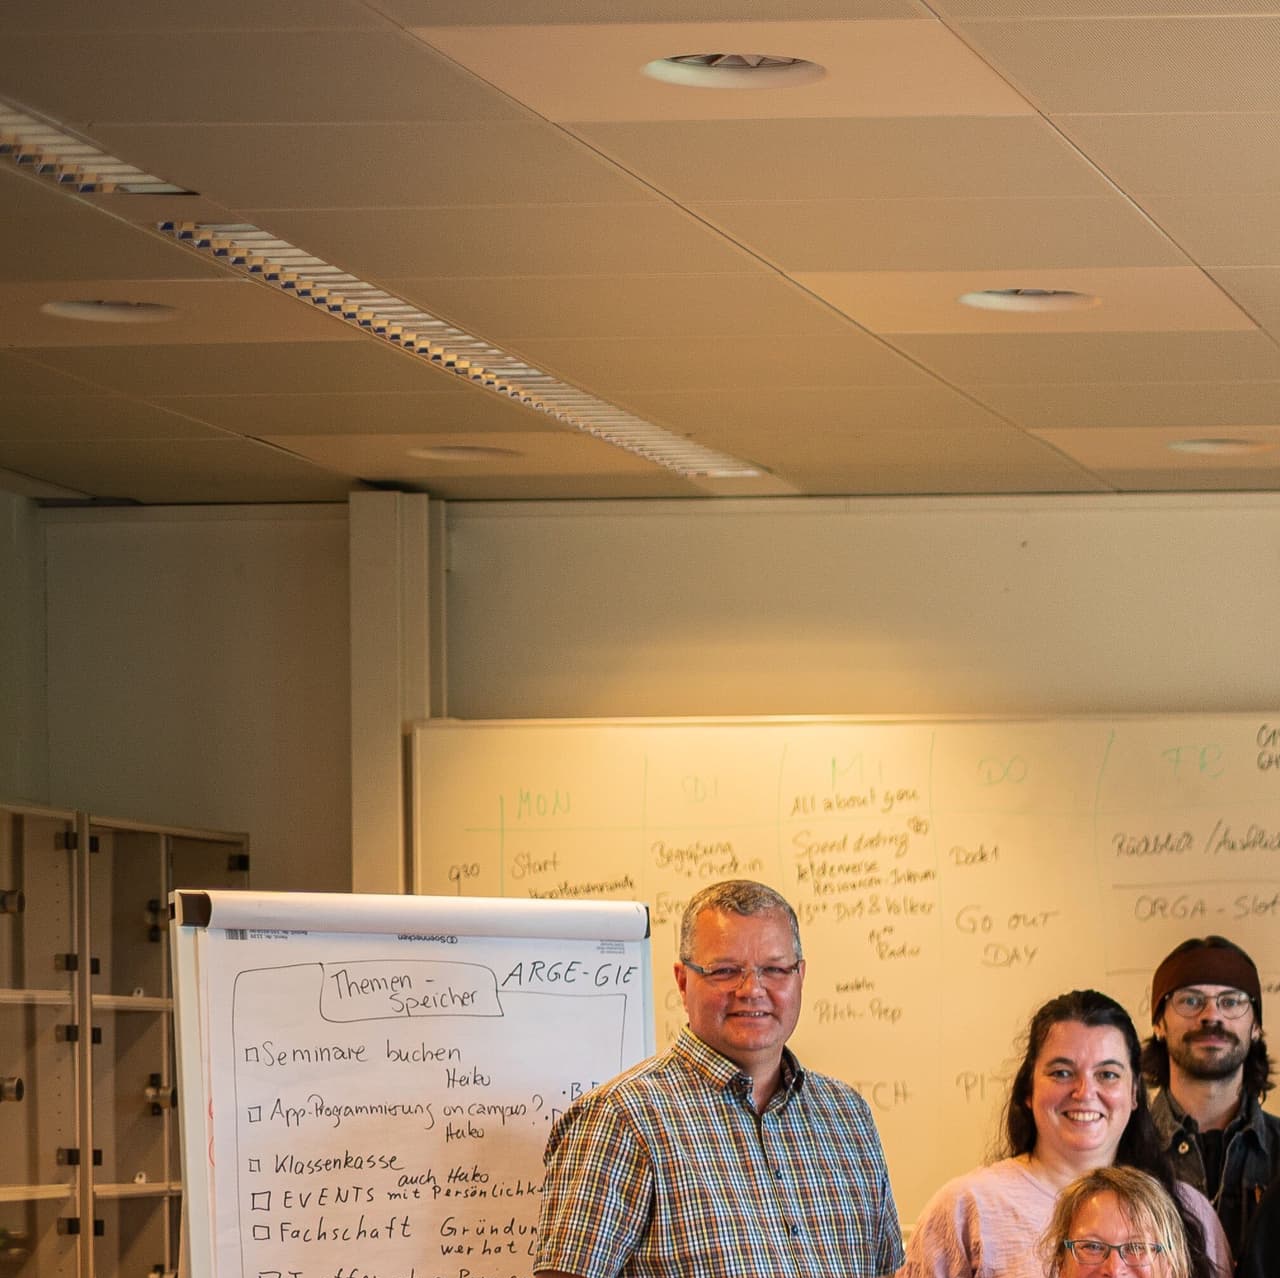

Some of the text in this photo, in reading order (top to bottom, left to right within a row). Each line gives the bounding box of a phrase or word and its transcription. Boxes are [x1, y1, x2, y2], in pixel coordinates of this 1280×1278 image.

[389, 986, 477, 1017] Speicher
[262, 1039, 462, 1067] Seminare buchen
[275, 1150, 405, 1175] Klassenkasse
[398, 1169, 437, 1188] auch
[283, 1186, 375, 1209] EVENTS
[387, 1186, 420, 1200] mit
[280, 1215, 412, 1242] Fachschaft
[441, 1245, 474, 1256] wer
[482, 1239, 517, 1256] hat
